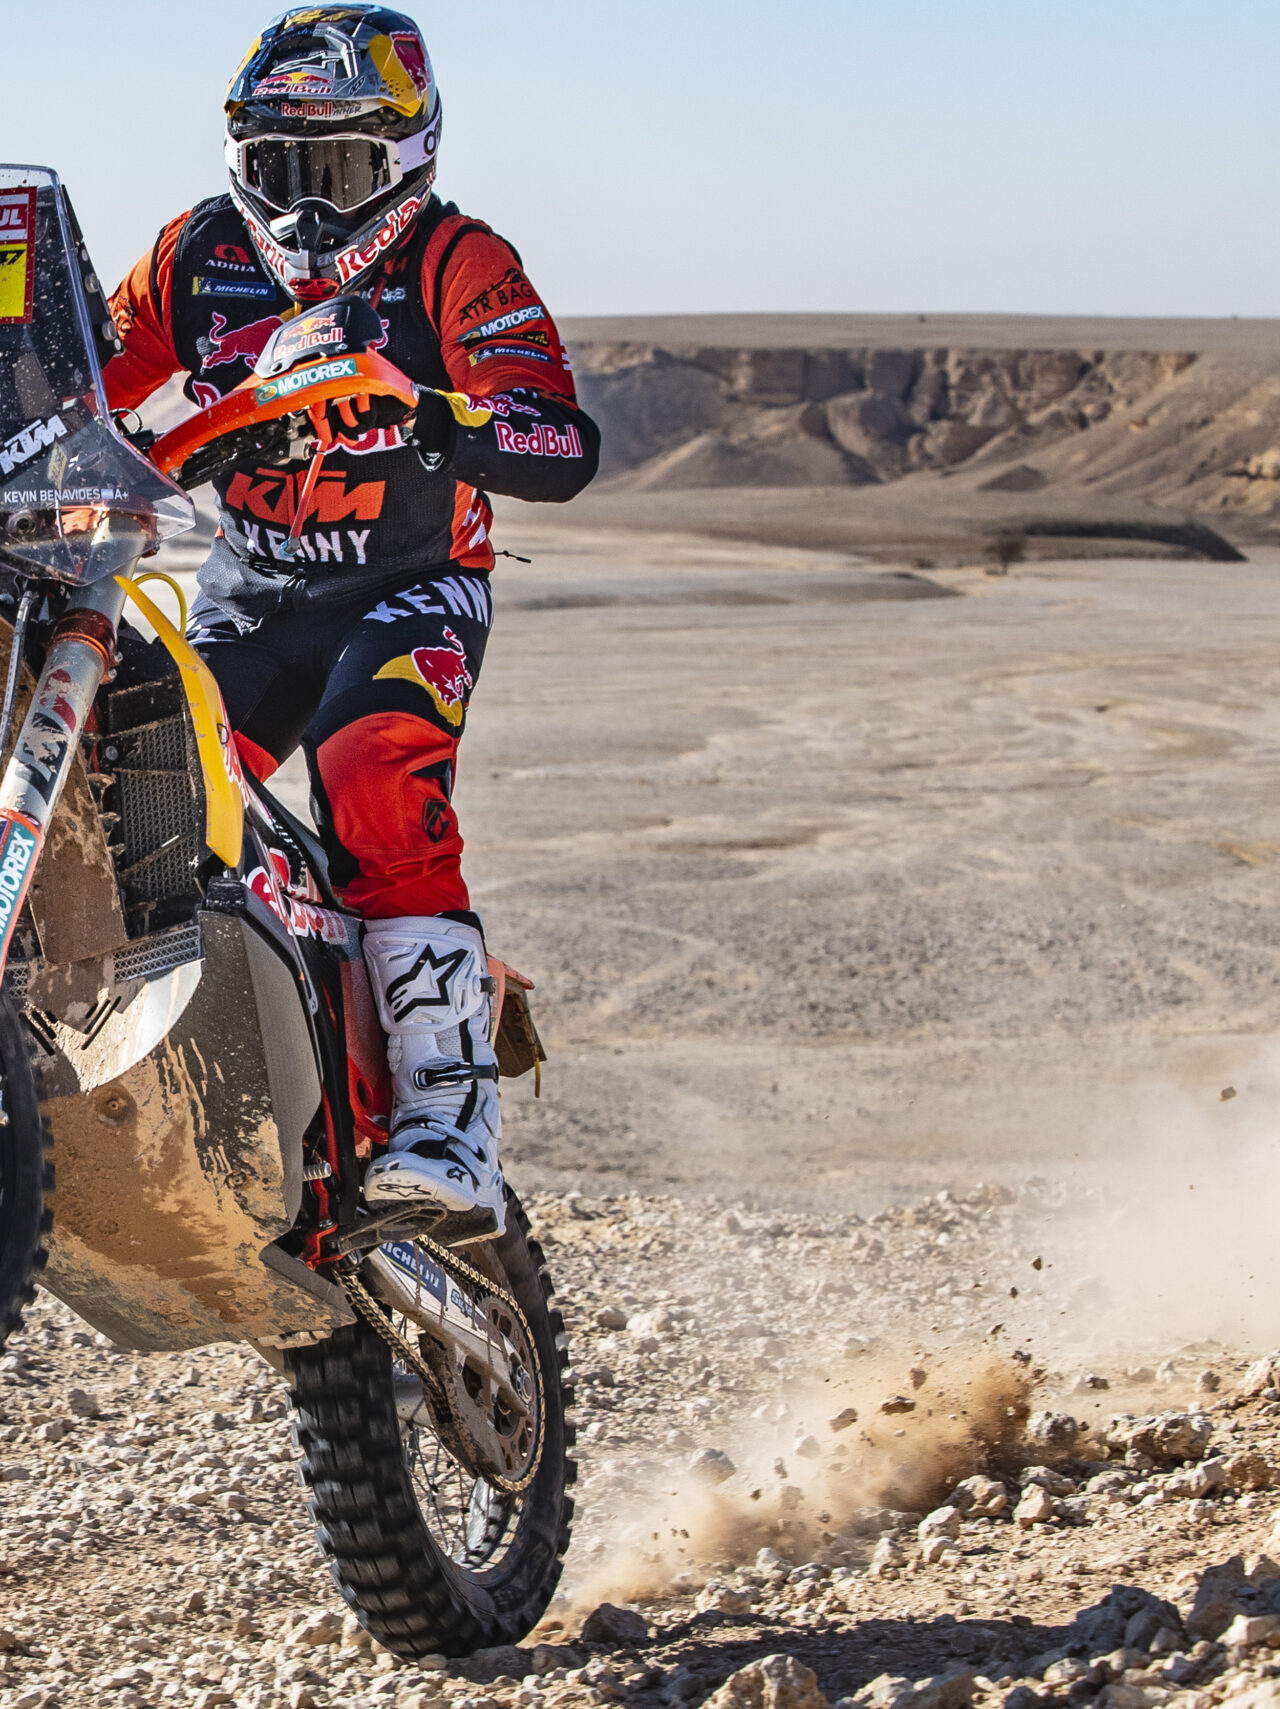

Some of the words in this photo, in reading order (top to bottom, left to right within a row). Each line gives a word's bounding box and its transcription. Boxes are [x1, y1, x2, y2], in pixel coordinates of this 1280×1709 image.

[204, 258, 257, 273] ADRIA
[214, 284, 269, 296] MICHELIN
[496, 282, 534, 306] BAG
[480, 305, 545, 337] MOTOREX
[494, 347, 549, 361] MICHELIN
[277, 360, 354, 395] MOTOREX
[3, 490, 37, 504] KEVIN
[39, 488, 101, 503] BENAVIDES
[114, 488, 129, 500] A+
[225, 466, 386, 527] KTM
[362, 575, 495, 628] KENN
